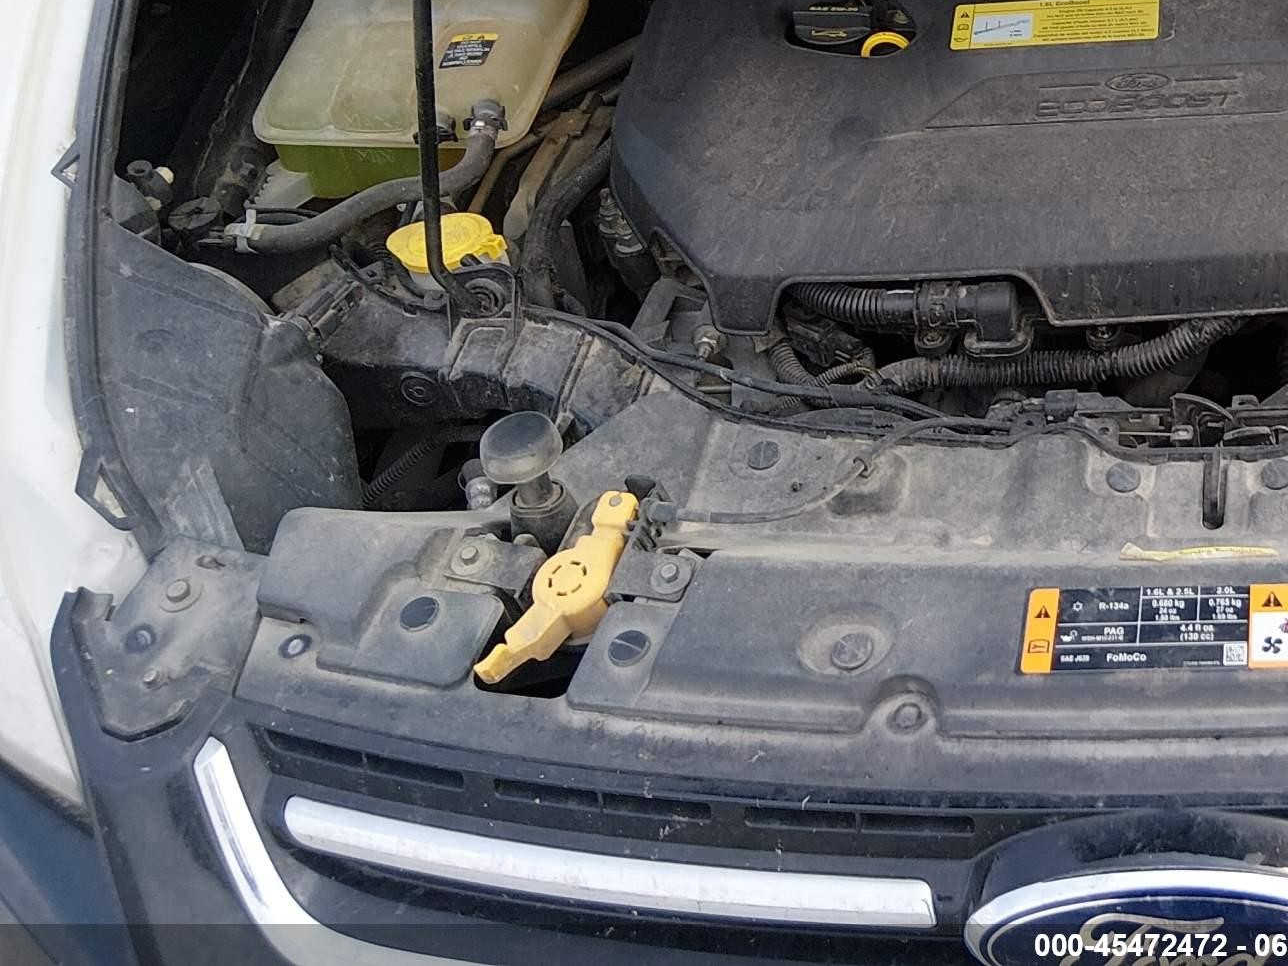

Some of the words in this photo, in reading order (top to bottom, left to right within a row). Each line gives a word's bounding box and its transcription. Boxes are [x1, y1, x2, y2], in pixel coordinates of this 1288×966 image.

[1035, 91, 1239, 117] ECOBOOST
[1216, 586, 1236, 595] 2.0L
[1098, 601, 1130, 611] R-134a
[1174, 599, 1185, 609] kg
[1231, 598, 1242, 608] kg
[1103, 626, 1125, 636] PAG
[1179, 623, 1193, 632] 4.4
[1179, 632, 1199, 642] (130
[1200, 632, 1214, 641] cc)
[1105, 652, 1148, 663] FoMoCo
